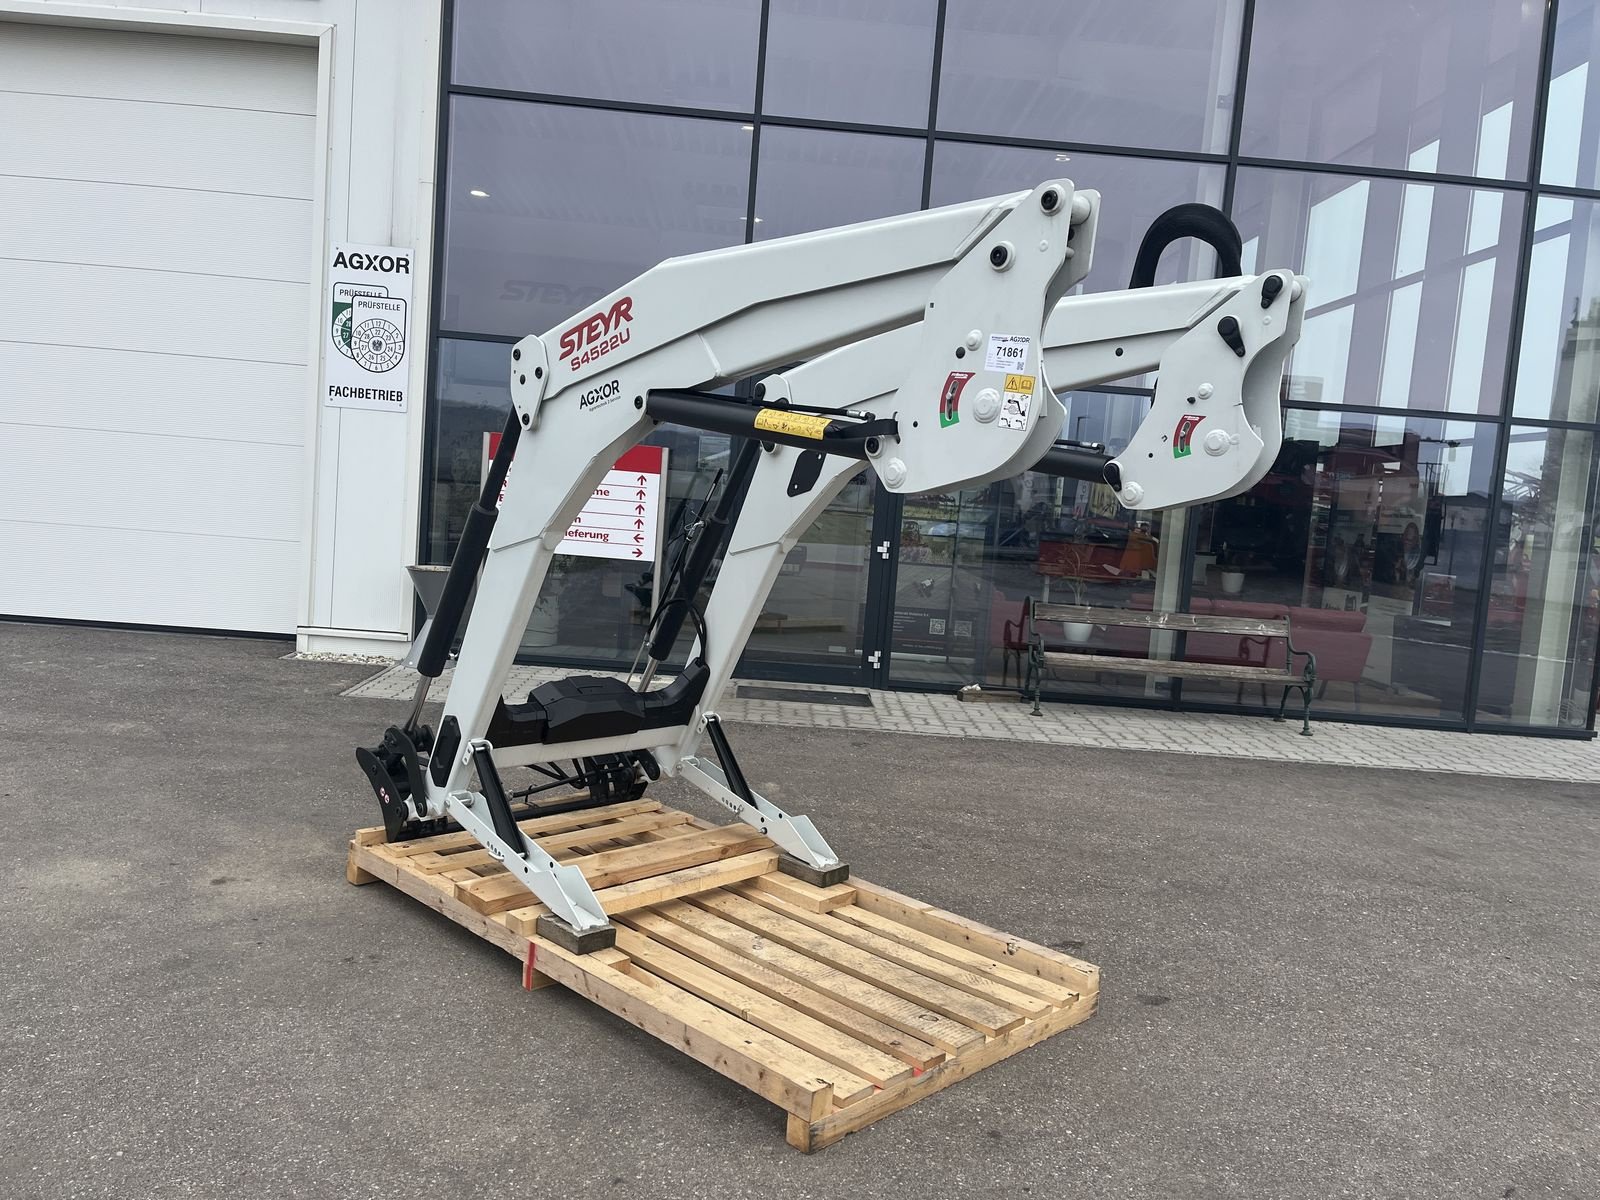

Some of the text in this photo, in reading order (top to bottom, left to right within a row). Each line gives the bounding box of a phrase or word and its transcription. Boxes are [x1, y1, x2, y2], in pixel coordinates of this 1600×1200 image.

[333, 252, 409, 274] AGXOR
[357, 301, 401, 311] PRÜFSTELLE
[559, 296, 634, 361] STEYR
[571, 328, 630, 371] S4522U
[996, 346, 1024, 358] 71861
[329, 385, 403, 402] FACHBETRIEB
[580, 380, 620, 410] AGXOR
